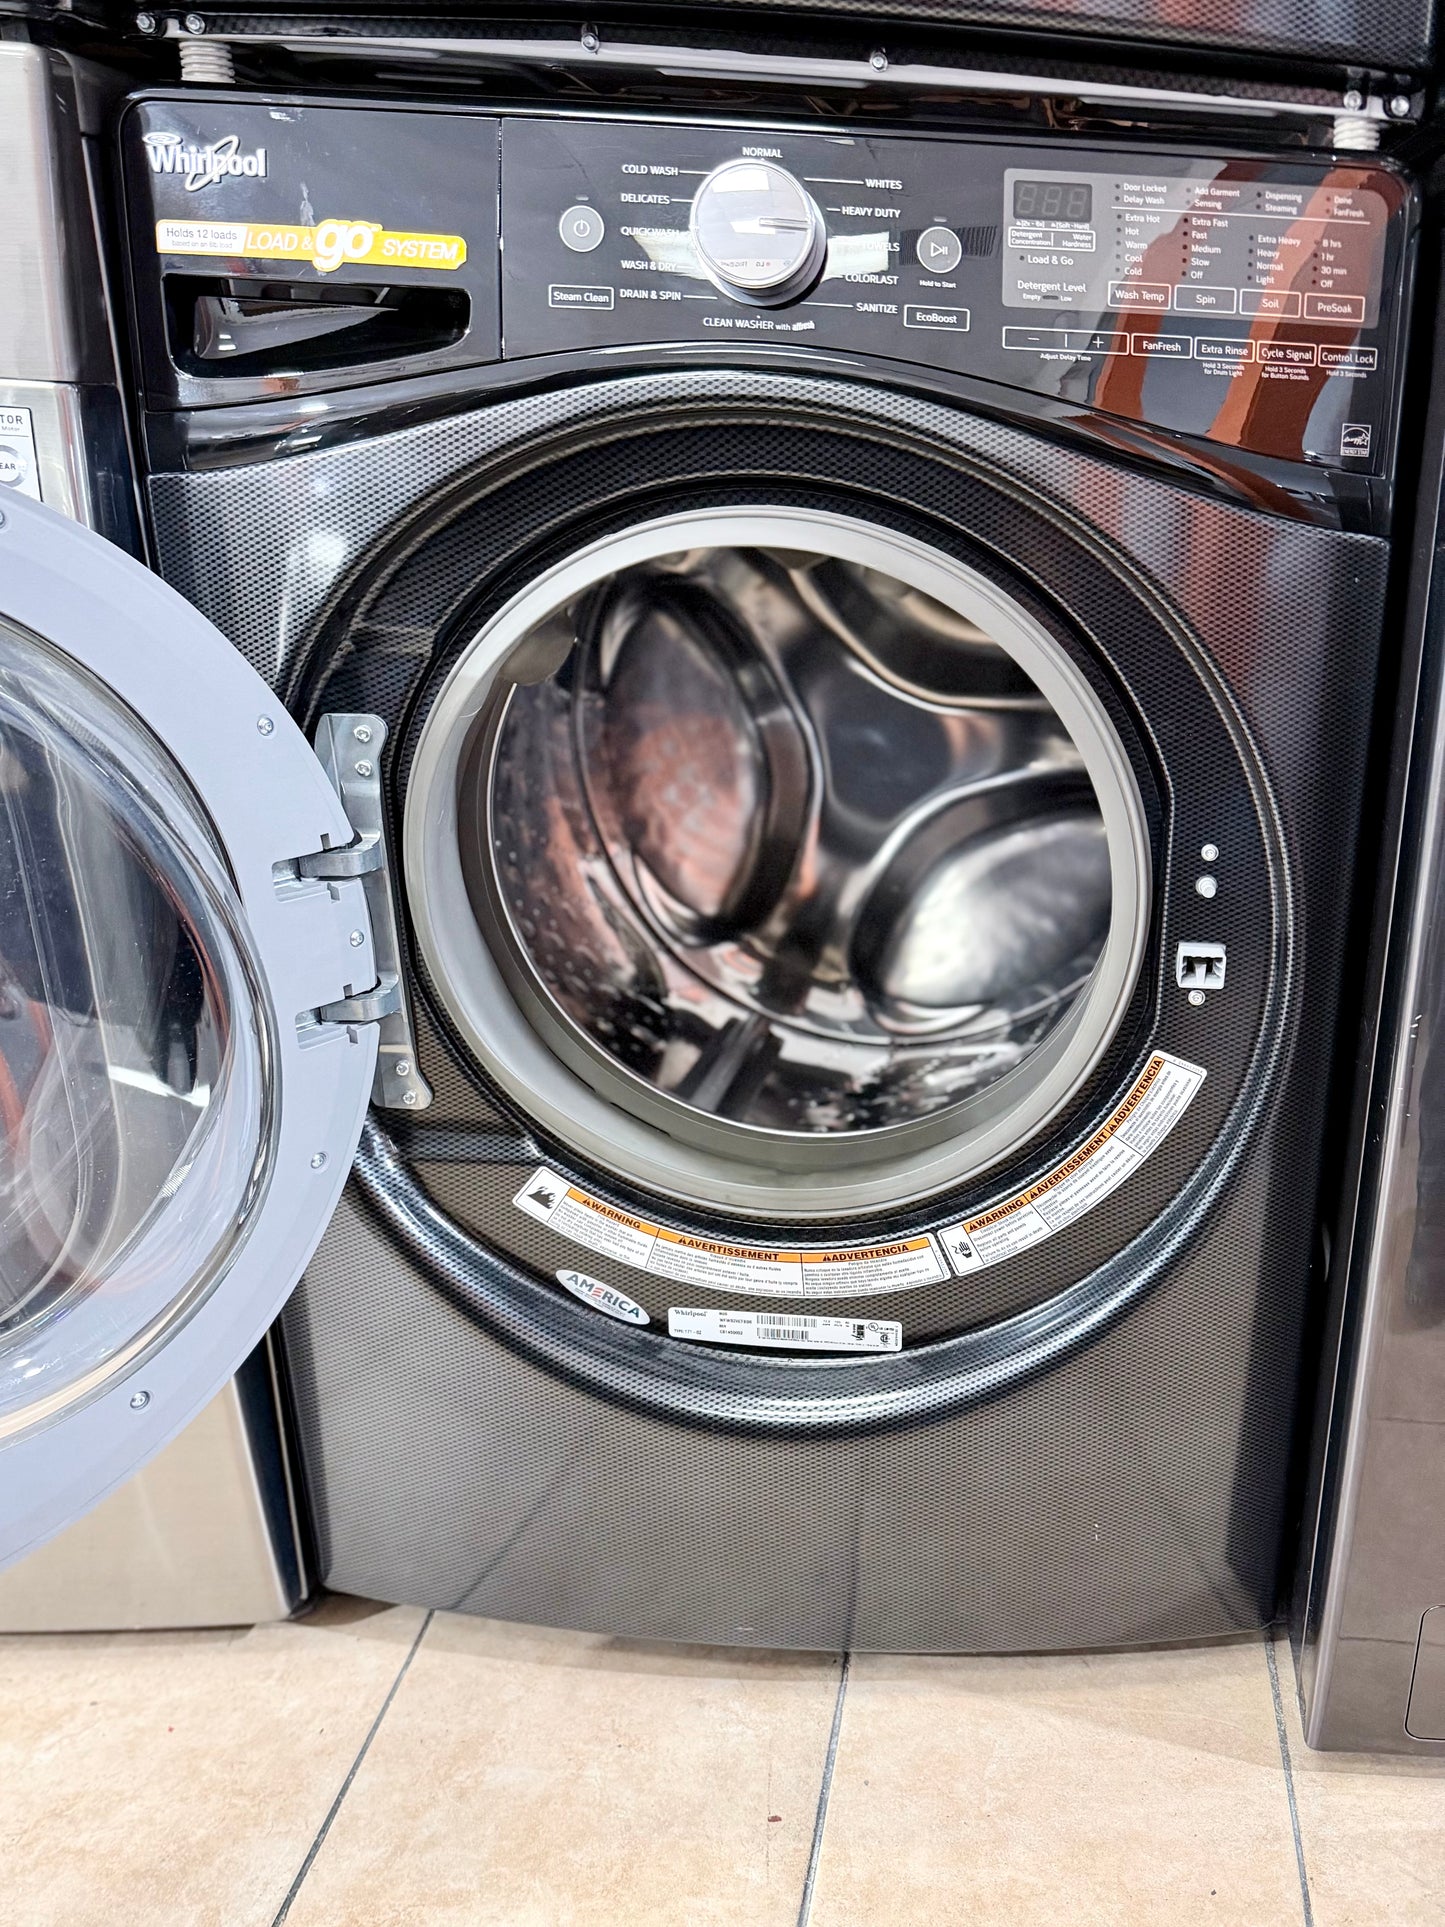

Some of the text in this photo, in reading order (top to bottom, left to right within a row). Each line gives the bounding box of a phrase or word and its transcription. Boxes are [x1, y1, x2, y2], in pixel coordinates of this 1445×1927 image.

[742, 147, 783, 158] NORMAL
[147, 140, 267, 188] Whirlpool
[622, 164, 679, 176] COLD WASH
[865, 179, 902, 190] WHITES
[1124, 183, 1167, 193] Door Locked
[1194, 187, 1240, 197] Add Garment
[1265, 191, 1302, 203] Dispensing
[621, 194, 670, 205] DELICATES
[1123, 195, 1143, 205] Delay
[1195, 199, 1222, 210] Sensing
[842, 206, 901, 218] HEAVY DUTY
[1265, 204, 1297, 215] Steaming
[1334, 208, 1364, 217] FanFresh
[1146, 215, 1160, 223] Hot
[1192, 217, 1228, 227] Extra Fast
[166, 228, 237, 240] Holds 12 loads
[621, 226, 680, 236] QUICKWASH
[1011, 230, 1043, 239] Detergent
[1125, 227, 1139, 235] Hot
[1192, 231, 1207, 239] Fast
[247, 232, 313, 250] LOAD &
[315, 223, 374, 268] go
[1062, 240, 1091, 248] Hardness
[1125, 241, 1148, 249] Warm
[1258, 235, 1301, 247] Extra Heavy
[1330, 240, 1342, 248] hrs
[382, 238, 458, 260] SYSTEM
[863, 242, 900, 252] TOWELS
[1191, 245, 1221, 254] Medium
[1125, 254, 1143, 262] Cool
[1257, 249, 1279, 259] Heavy
[1326, 253, 1334, 261] hr
[1028, 255, 1074, 265] Load & Go
[1191, 258, 1209, 266] Slow
[621, 260, 676, 271] WASH & DRY
[1257, 262, 1284, 271] Normal
[1321, 266, 1347, 275] 30 min
[1124, 267, 1142, 275] Cold
[1191, 271, 1203, 279] Off
[845, 273, 899, 285] COLORLAST
[919, 279, 933, 287] Hold
[1256, 275, 1274, 285] Light
[1321, 280, 1333, 288] Off
[1018, 280, 1087, 292] Detergent Level
[553, 291, 609, 303] Steam Clean
[620, 289, 681, 301] DRAIN & SPIN
[1023, 293, 1041, 301] Empty
[1115, 289, 1165, 303] Wash Temp
[1196, 295, 1216, 305] Spin
[856, 303, 898, 313] SANITIZE
[1262, 299, 1279, 308] Soil
[1318, 302, 1352, 313] PreSoak
[916, 313, 957, 324] EcoBoost
[703, 317, 733, 327] CLEAN
[735, 319, 774, 330] WASHER
[775, 323, 790, 331] with
[1143, 341, 1181, 352] FanFresh
[1201, 345, 1248, 355] Extra Rinse
[1060, 353, 1076, 362] Delay
[1261, 348, 1312, 361] Cycle Signal
[1322, 352, 1374, 364] Control Lock
[0, 415, 23, 424] TOR
[1114, 1060, 1162, 1126] ADVERTENCIA
[1037, 1132, 1108, 1194] AVERTISSEMENT
[590, 1203, 641, 1229] WARNING
[975, 1200, 1024, 1227] WARNING
[688, 1239, 779, 1261] AVERTISSEMENT
[831, 1244, 909, 1262] ADVERTENCIA
[566, 1274, 640, 1319] AMERICA
[674, 1310, 706, 1318] Whirlpool
